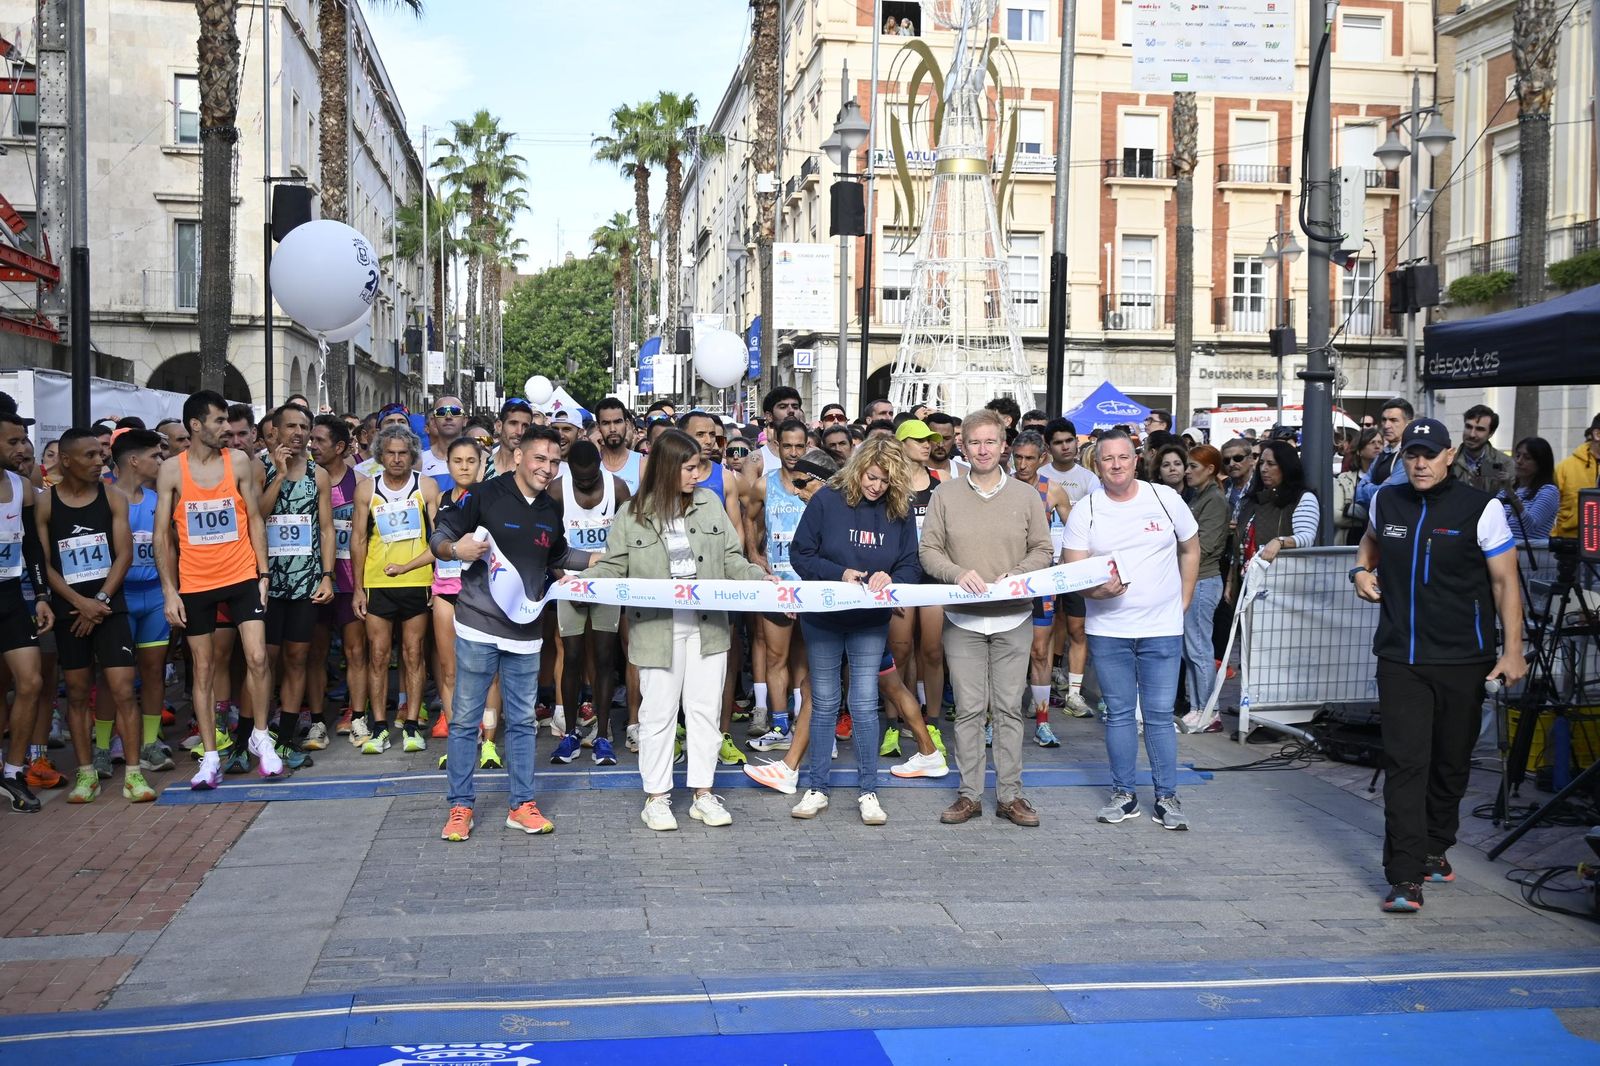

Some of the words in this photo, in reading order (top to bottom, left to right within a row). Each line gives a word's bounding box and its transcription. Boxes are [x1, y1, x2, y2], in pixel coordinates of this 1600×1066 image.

[1199, 368, 1253, 380] Deutsche
[195, 511, 229, 529] 106
[388, 511, 410, 527] 82
[279, 525, 300, 541] 89
[338, 531, 349, 546] 0
[576, 528, 608, 544] 180
[68, 545, 104, 567] 114
[1069, 579, 1094, 588] HUELVA
[714, 590, 757, 601] Huelva
